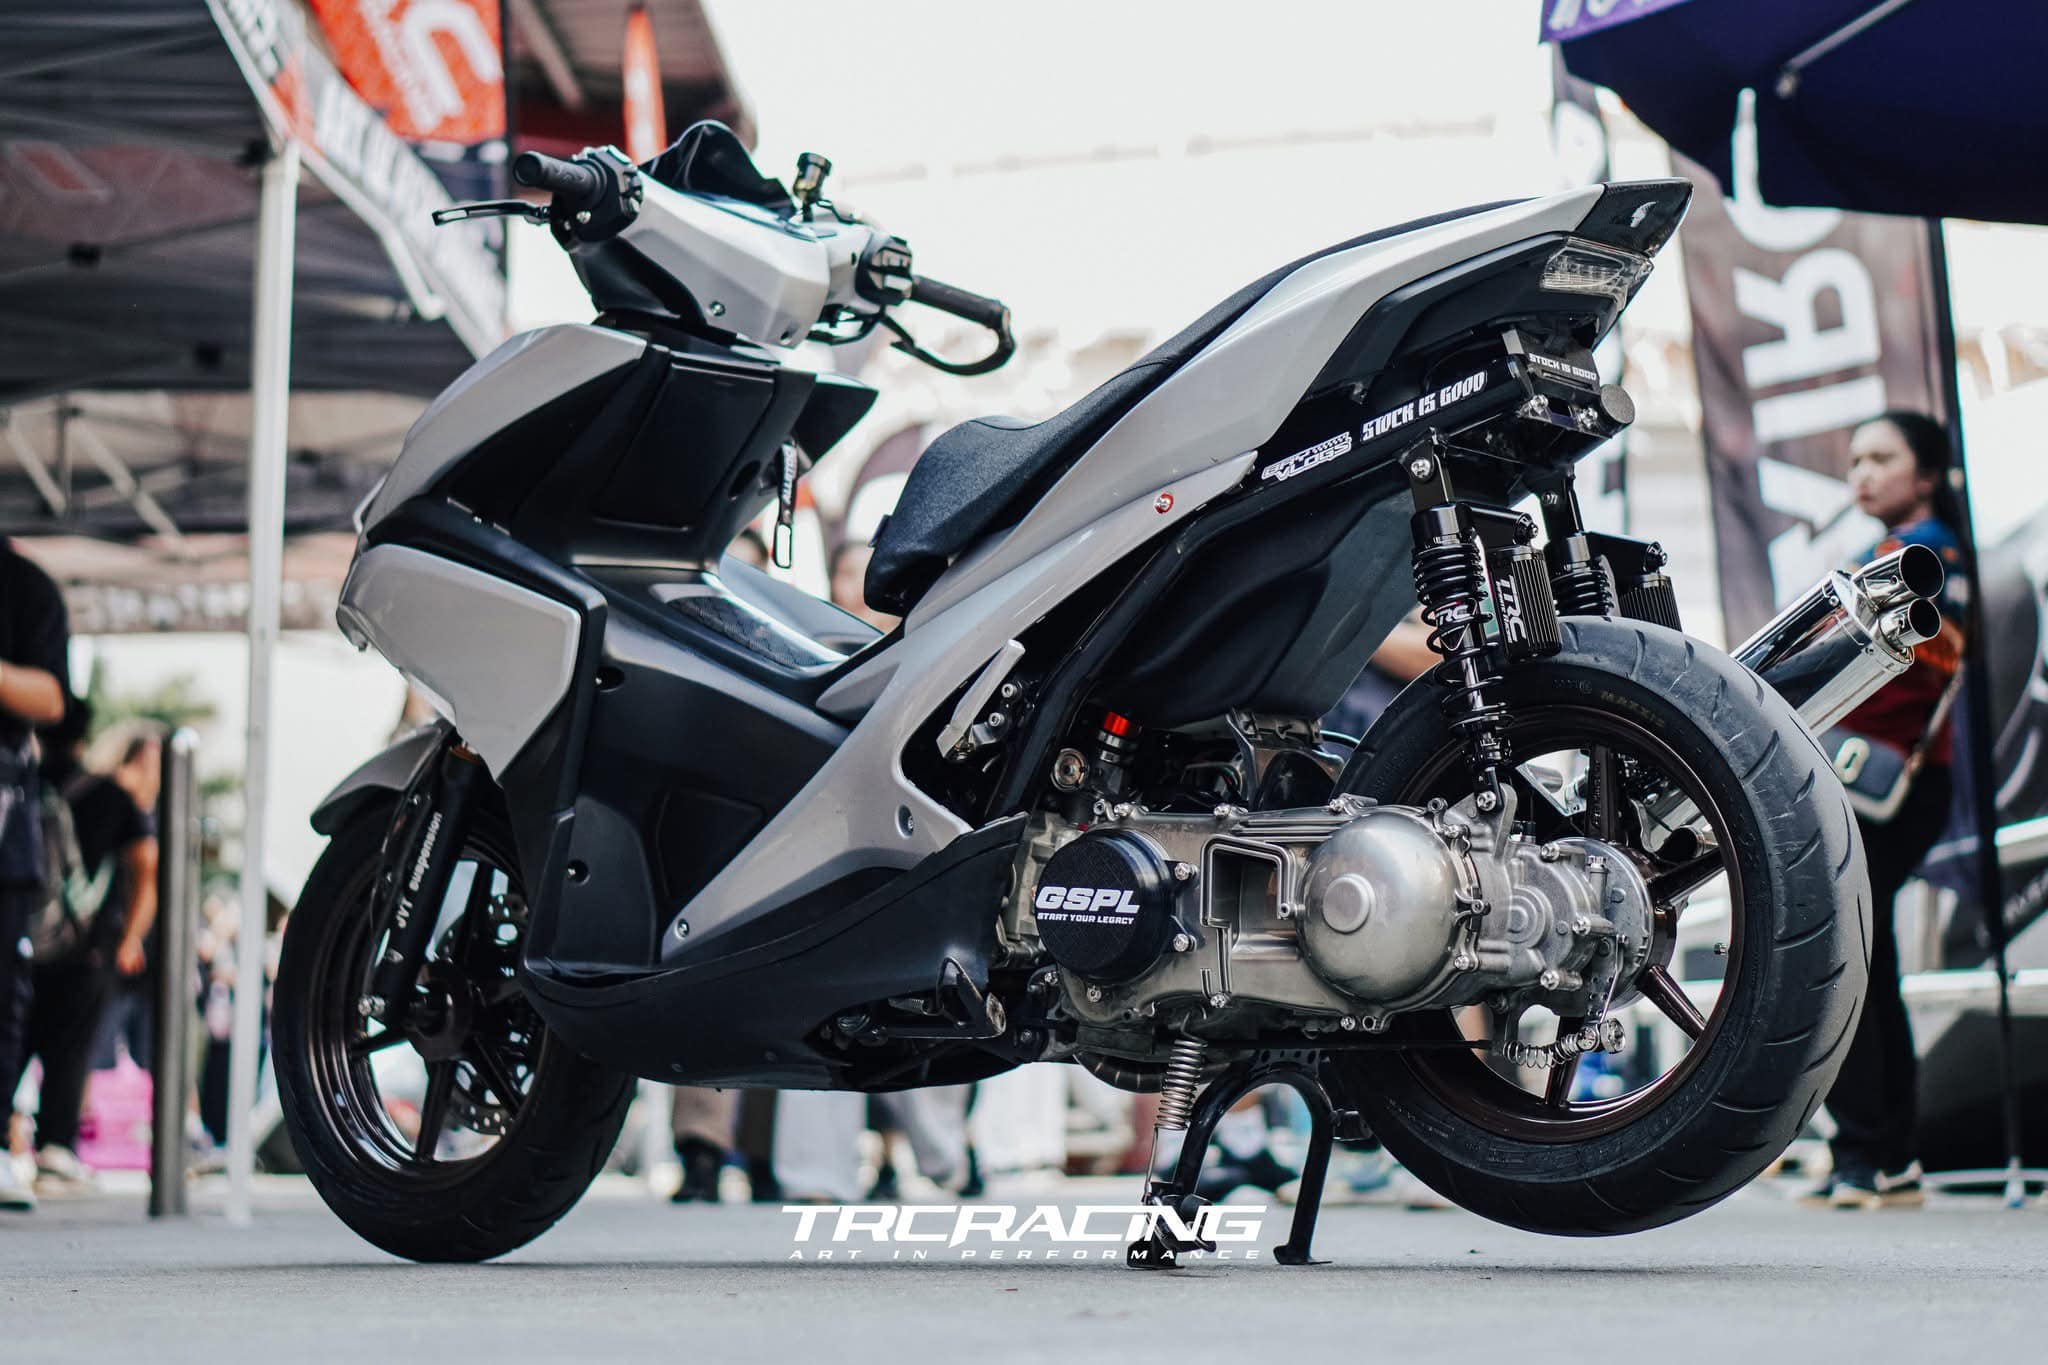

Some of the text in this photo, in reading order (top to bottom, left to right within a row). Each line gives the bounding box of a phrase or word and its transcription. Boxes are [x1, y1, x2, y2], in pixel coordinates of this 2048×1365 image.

[1528, 352, 1597, 381] STOCK IS GOOD
[1362, 371, 1486, 442] STOCK IS GOOD
[1500, 574, 1527, 643] TRC
[396, 811, 443, 929] JVT suspension
[1036, 886, 1140, 914] GSPL
[1037, 912, 1135, 925] START YOUR LEGACY
